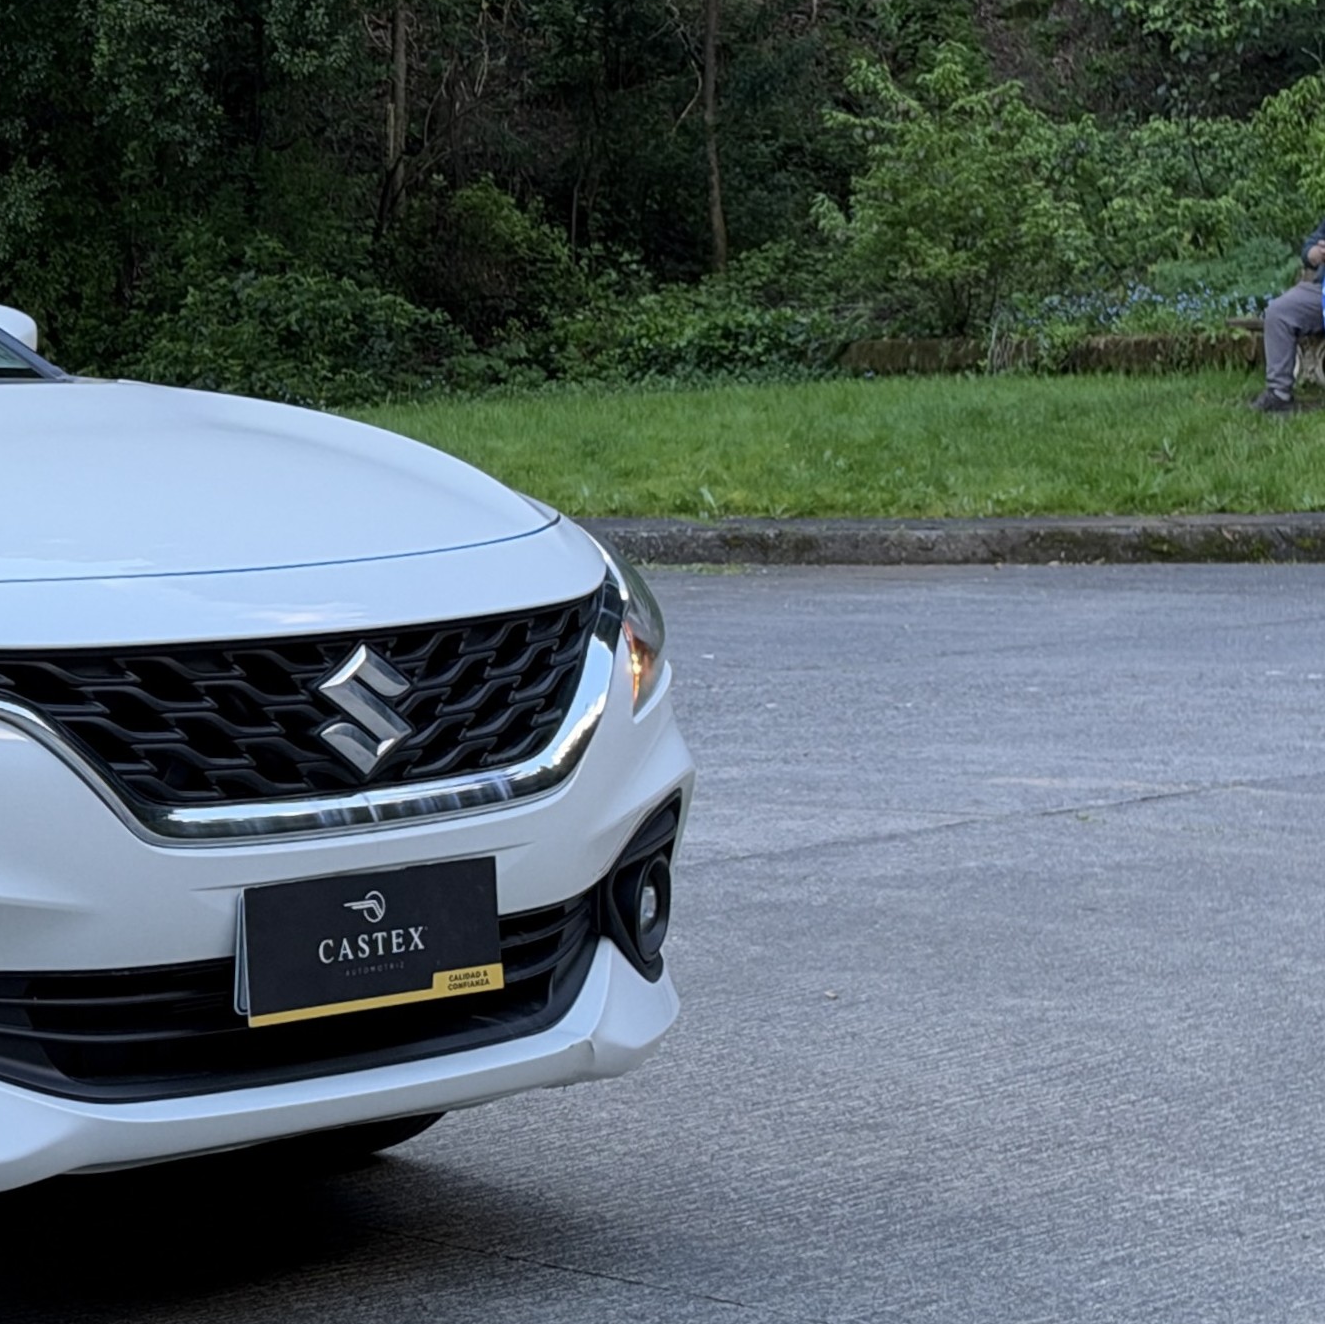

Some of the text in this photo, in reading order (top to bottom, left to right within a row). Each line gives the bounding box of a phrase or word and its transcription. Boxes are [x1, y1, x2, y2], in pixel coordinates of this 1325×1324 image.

[318, 926, 425, 964] CASTEX
[346, 961, 405, 976] AUTOMOTRIZ
[448, 970, 481, 983] CALIDAD
[447, 978, 491, 991] CONFIANZA
